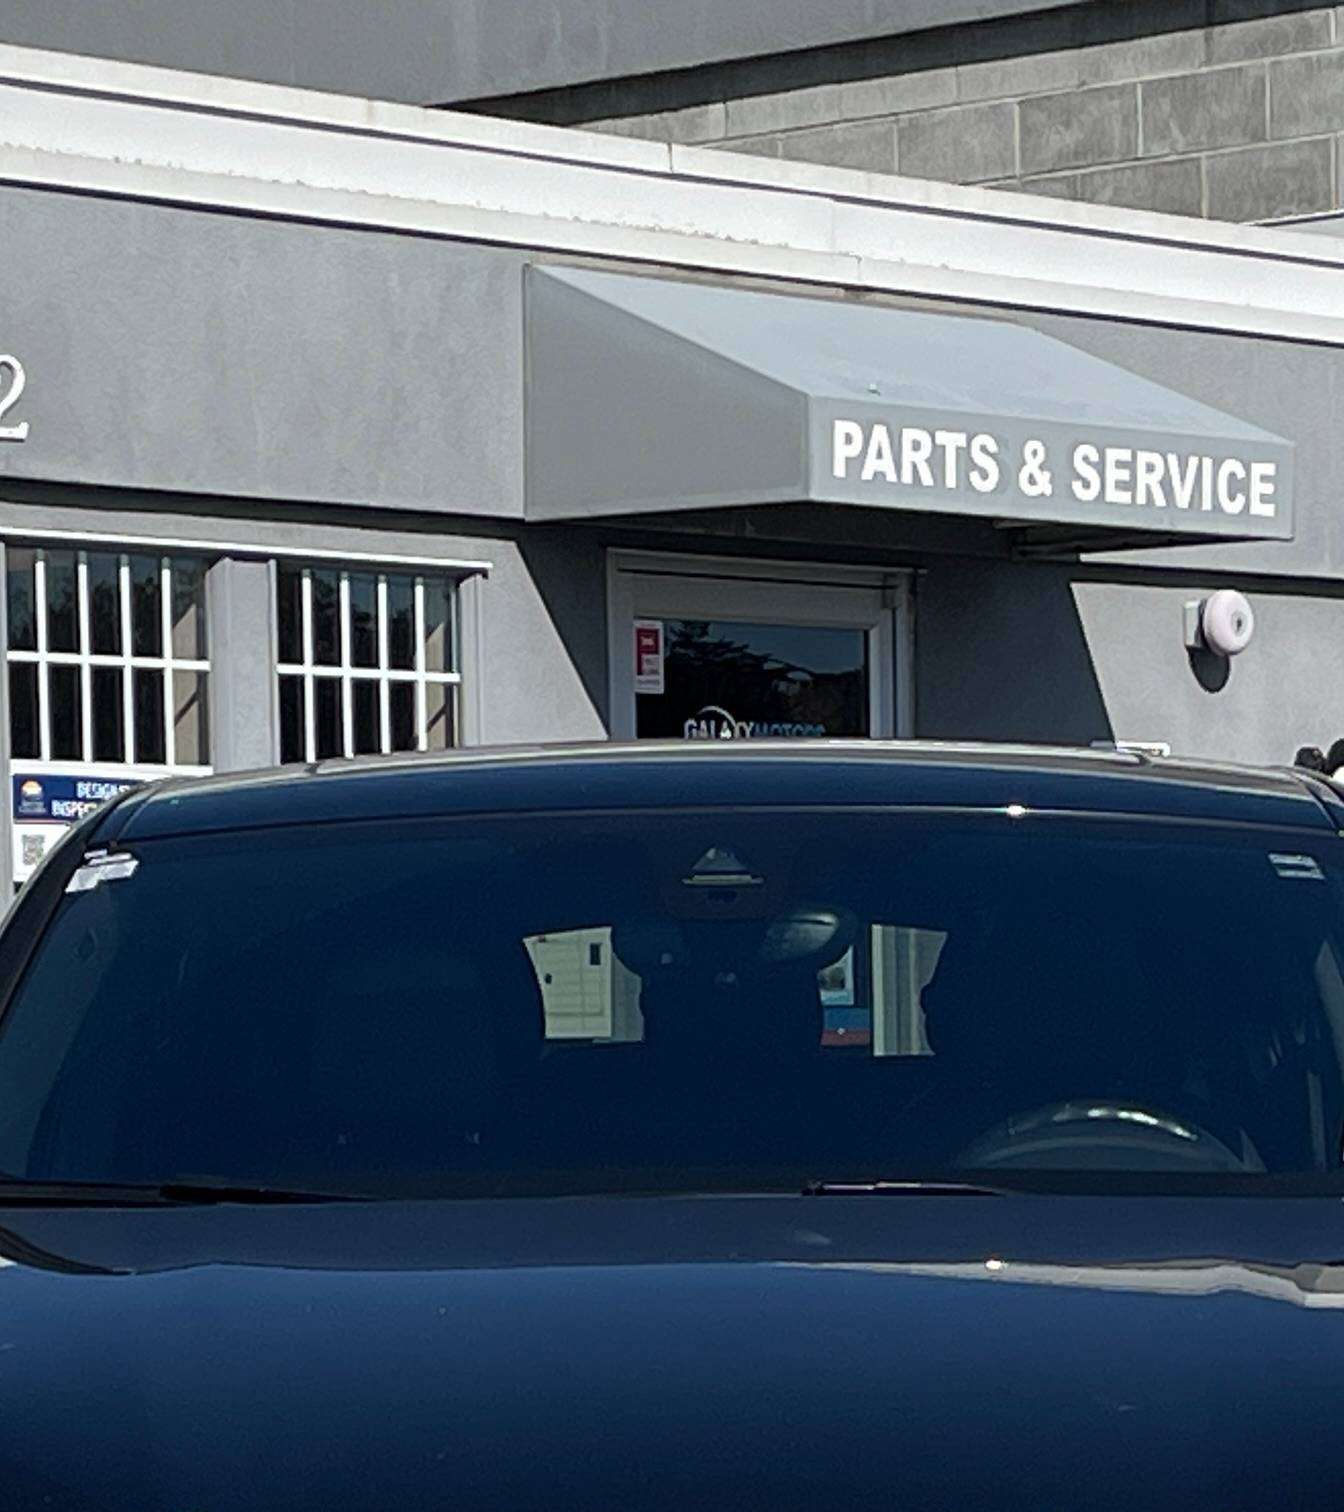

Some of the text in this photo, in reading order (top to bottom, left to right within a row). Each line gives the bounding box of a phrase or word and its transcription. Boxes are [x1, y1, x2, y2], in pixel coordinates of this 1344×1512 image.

[832, 419, 1277, 517] PARTS & SERVICE
